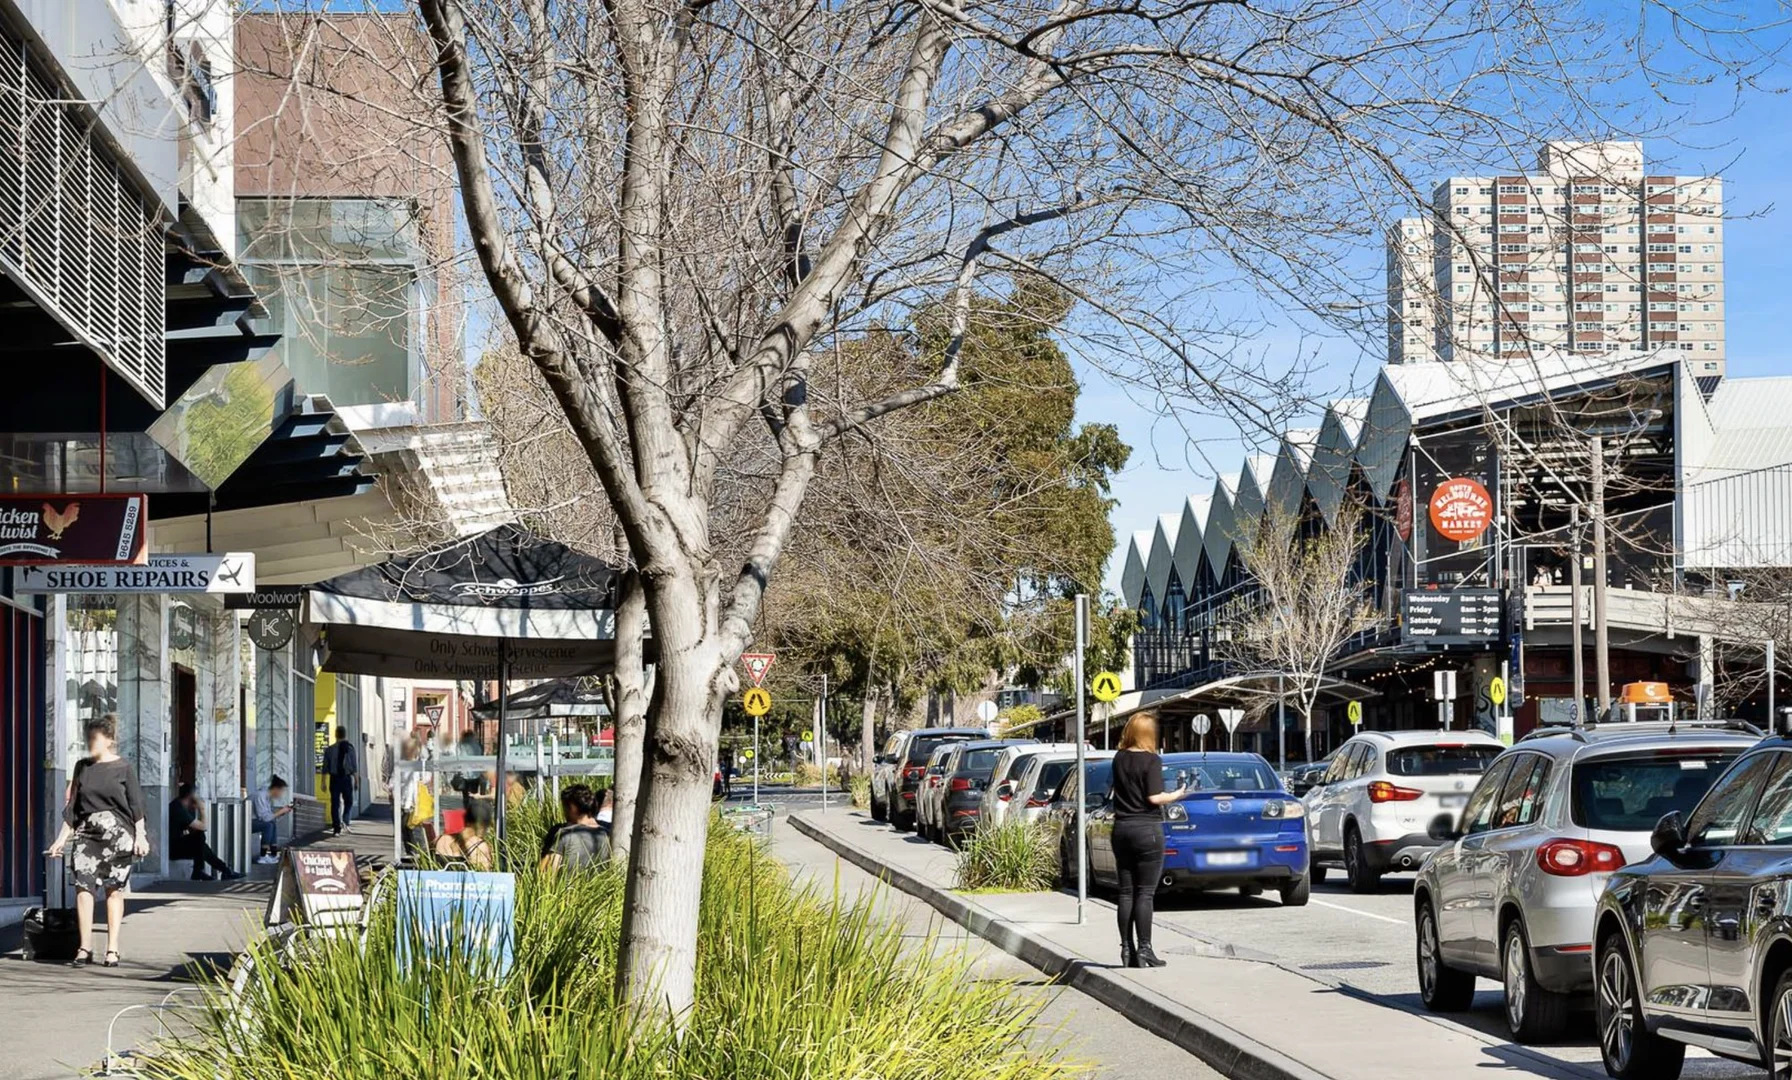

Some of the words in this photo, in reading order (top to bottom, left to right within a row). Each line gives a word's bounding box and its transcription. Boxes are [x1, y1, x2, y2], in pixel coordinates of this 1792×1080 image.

[1435, 491, 1488, 509] MELBOURNE
[124, 506, 137, 531] 5289
[1442, 520, 1482, 529] MARKET
[0, 524, 37, 539] twist
[119, 532, 131, 558] 9645
[180, 559, 189, 568] &
[47, 570, 108, 588] SHOE
[114, 569, 209, 588] REPAIRS
[463, 584, 553, 596] Schweppes
[1409, 595, 1450, 604] Wednesday
[1483, 595, 1499, 603] 4pm
[1409, 605, 1433, 614] Friday
[1483, 606, 1499, 614] 5pm
[1409, 616, 1442, 625] Saturday
[1483, 616, 1499, 624] 4pm
[261, 618, 280, 637] K
[1409, 627, 1437, 636] Sunday
[1483, 627, 1499, 635] 4pm
[430, 638, 457, 657] Only
[414, 659, 441, 675] Only
[303, 853, 331, 865] chicken
